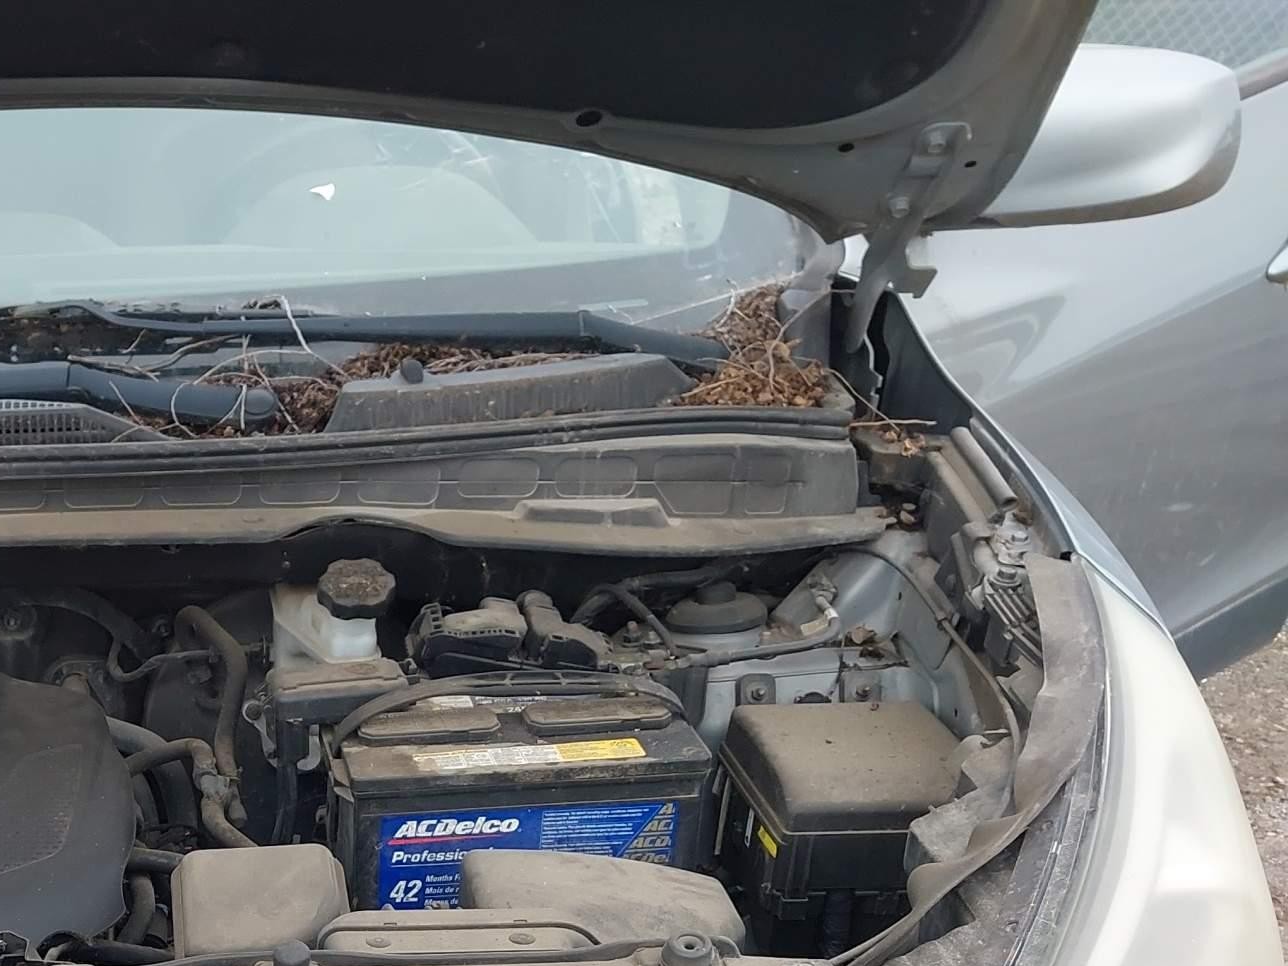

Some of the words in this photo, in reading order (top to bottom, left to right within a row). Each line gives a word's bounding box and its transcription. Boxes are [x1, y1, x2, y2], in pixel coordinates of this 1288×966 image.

[658, 802, 675, 815] A
[393, 816, 520, 839] ACDelco
[391, 848, 466, 864] Professio
[425, 874, 453, 884] Months
[389, 879, 422, 903] 42
